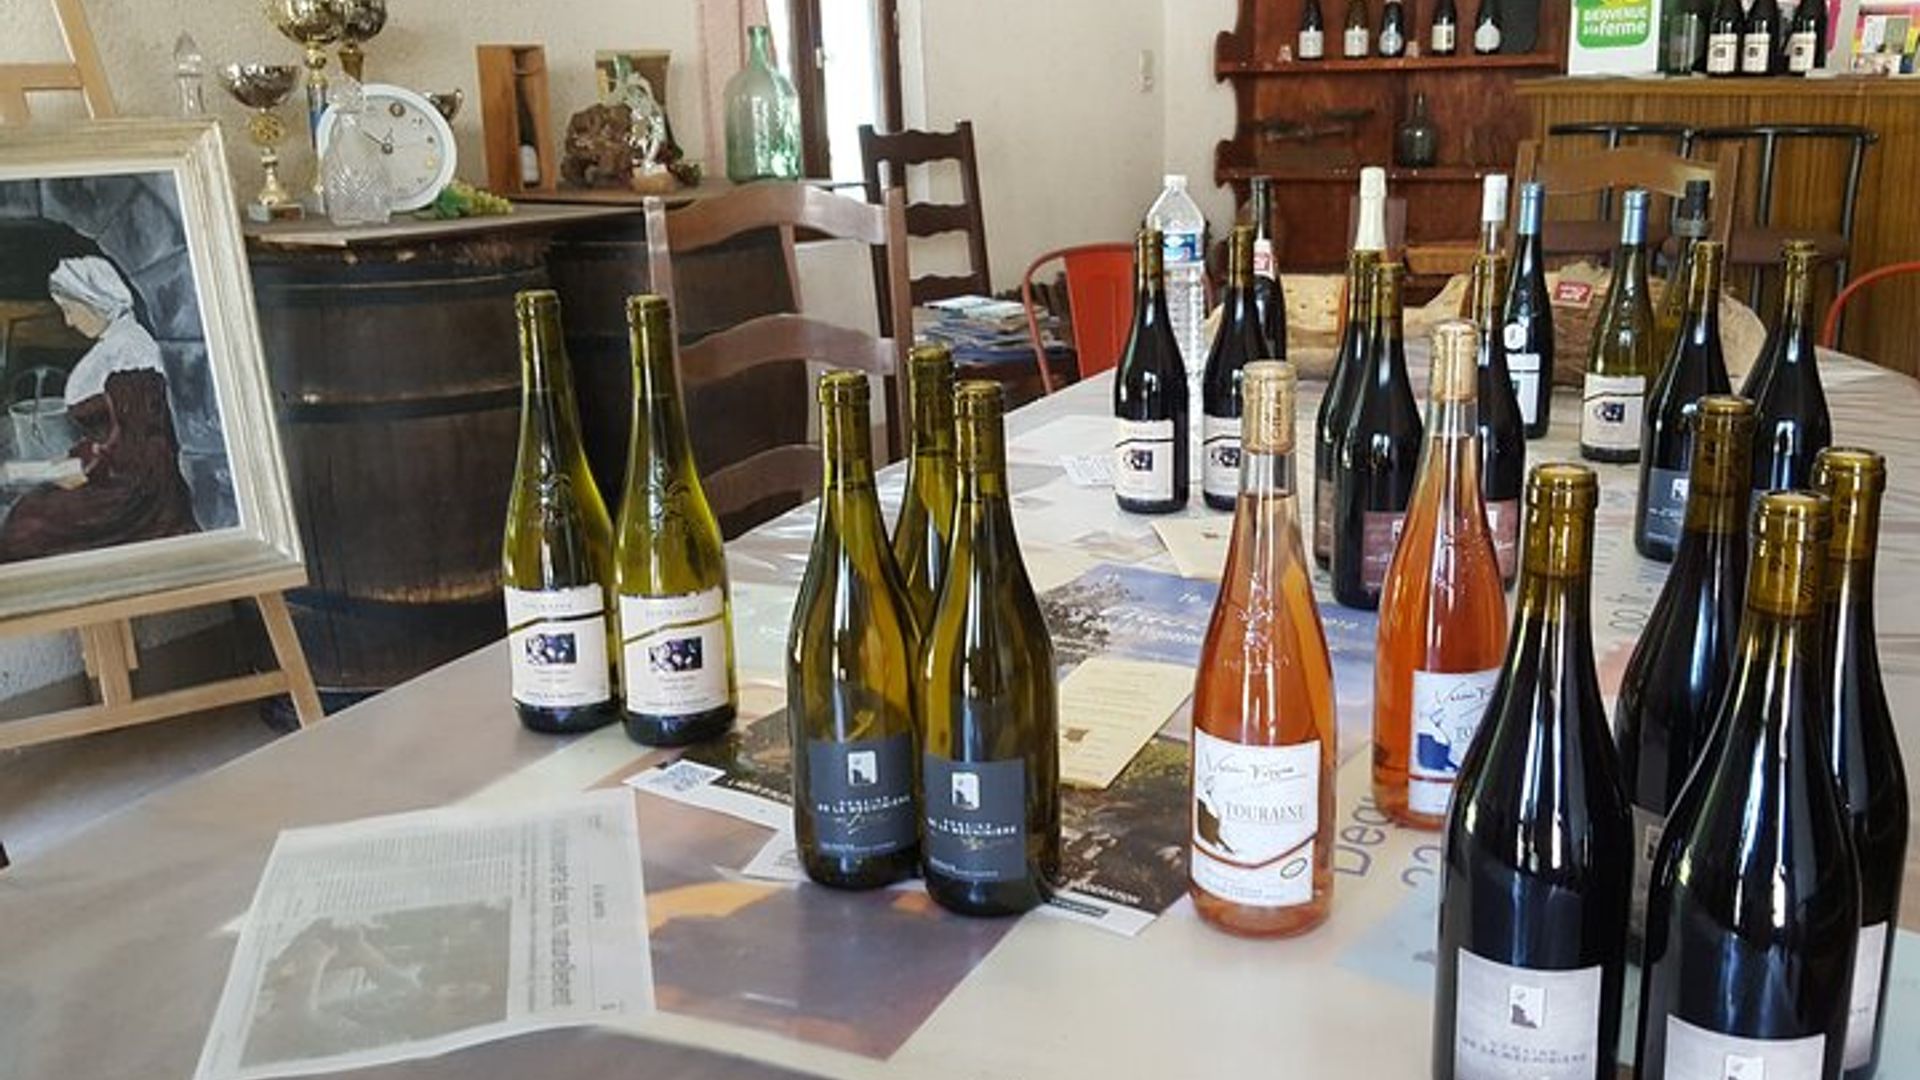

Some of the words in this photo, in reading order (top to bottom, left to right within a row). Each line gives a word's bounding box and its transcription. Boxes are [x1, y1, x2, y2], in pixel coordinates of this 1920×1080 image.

[1583, 6, 1647, 21] BIENVENUE
[1600, 21, 1647, 36] ferme
[1226, 801, 1306, 822] TOURAINE
